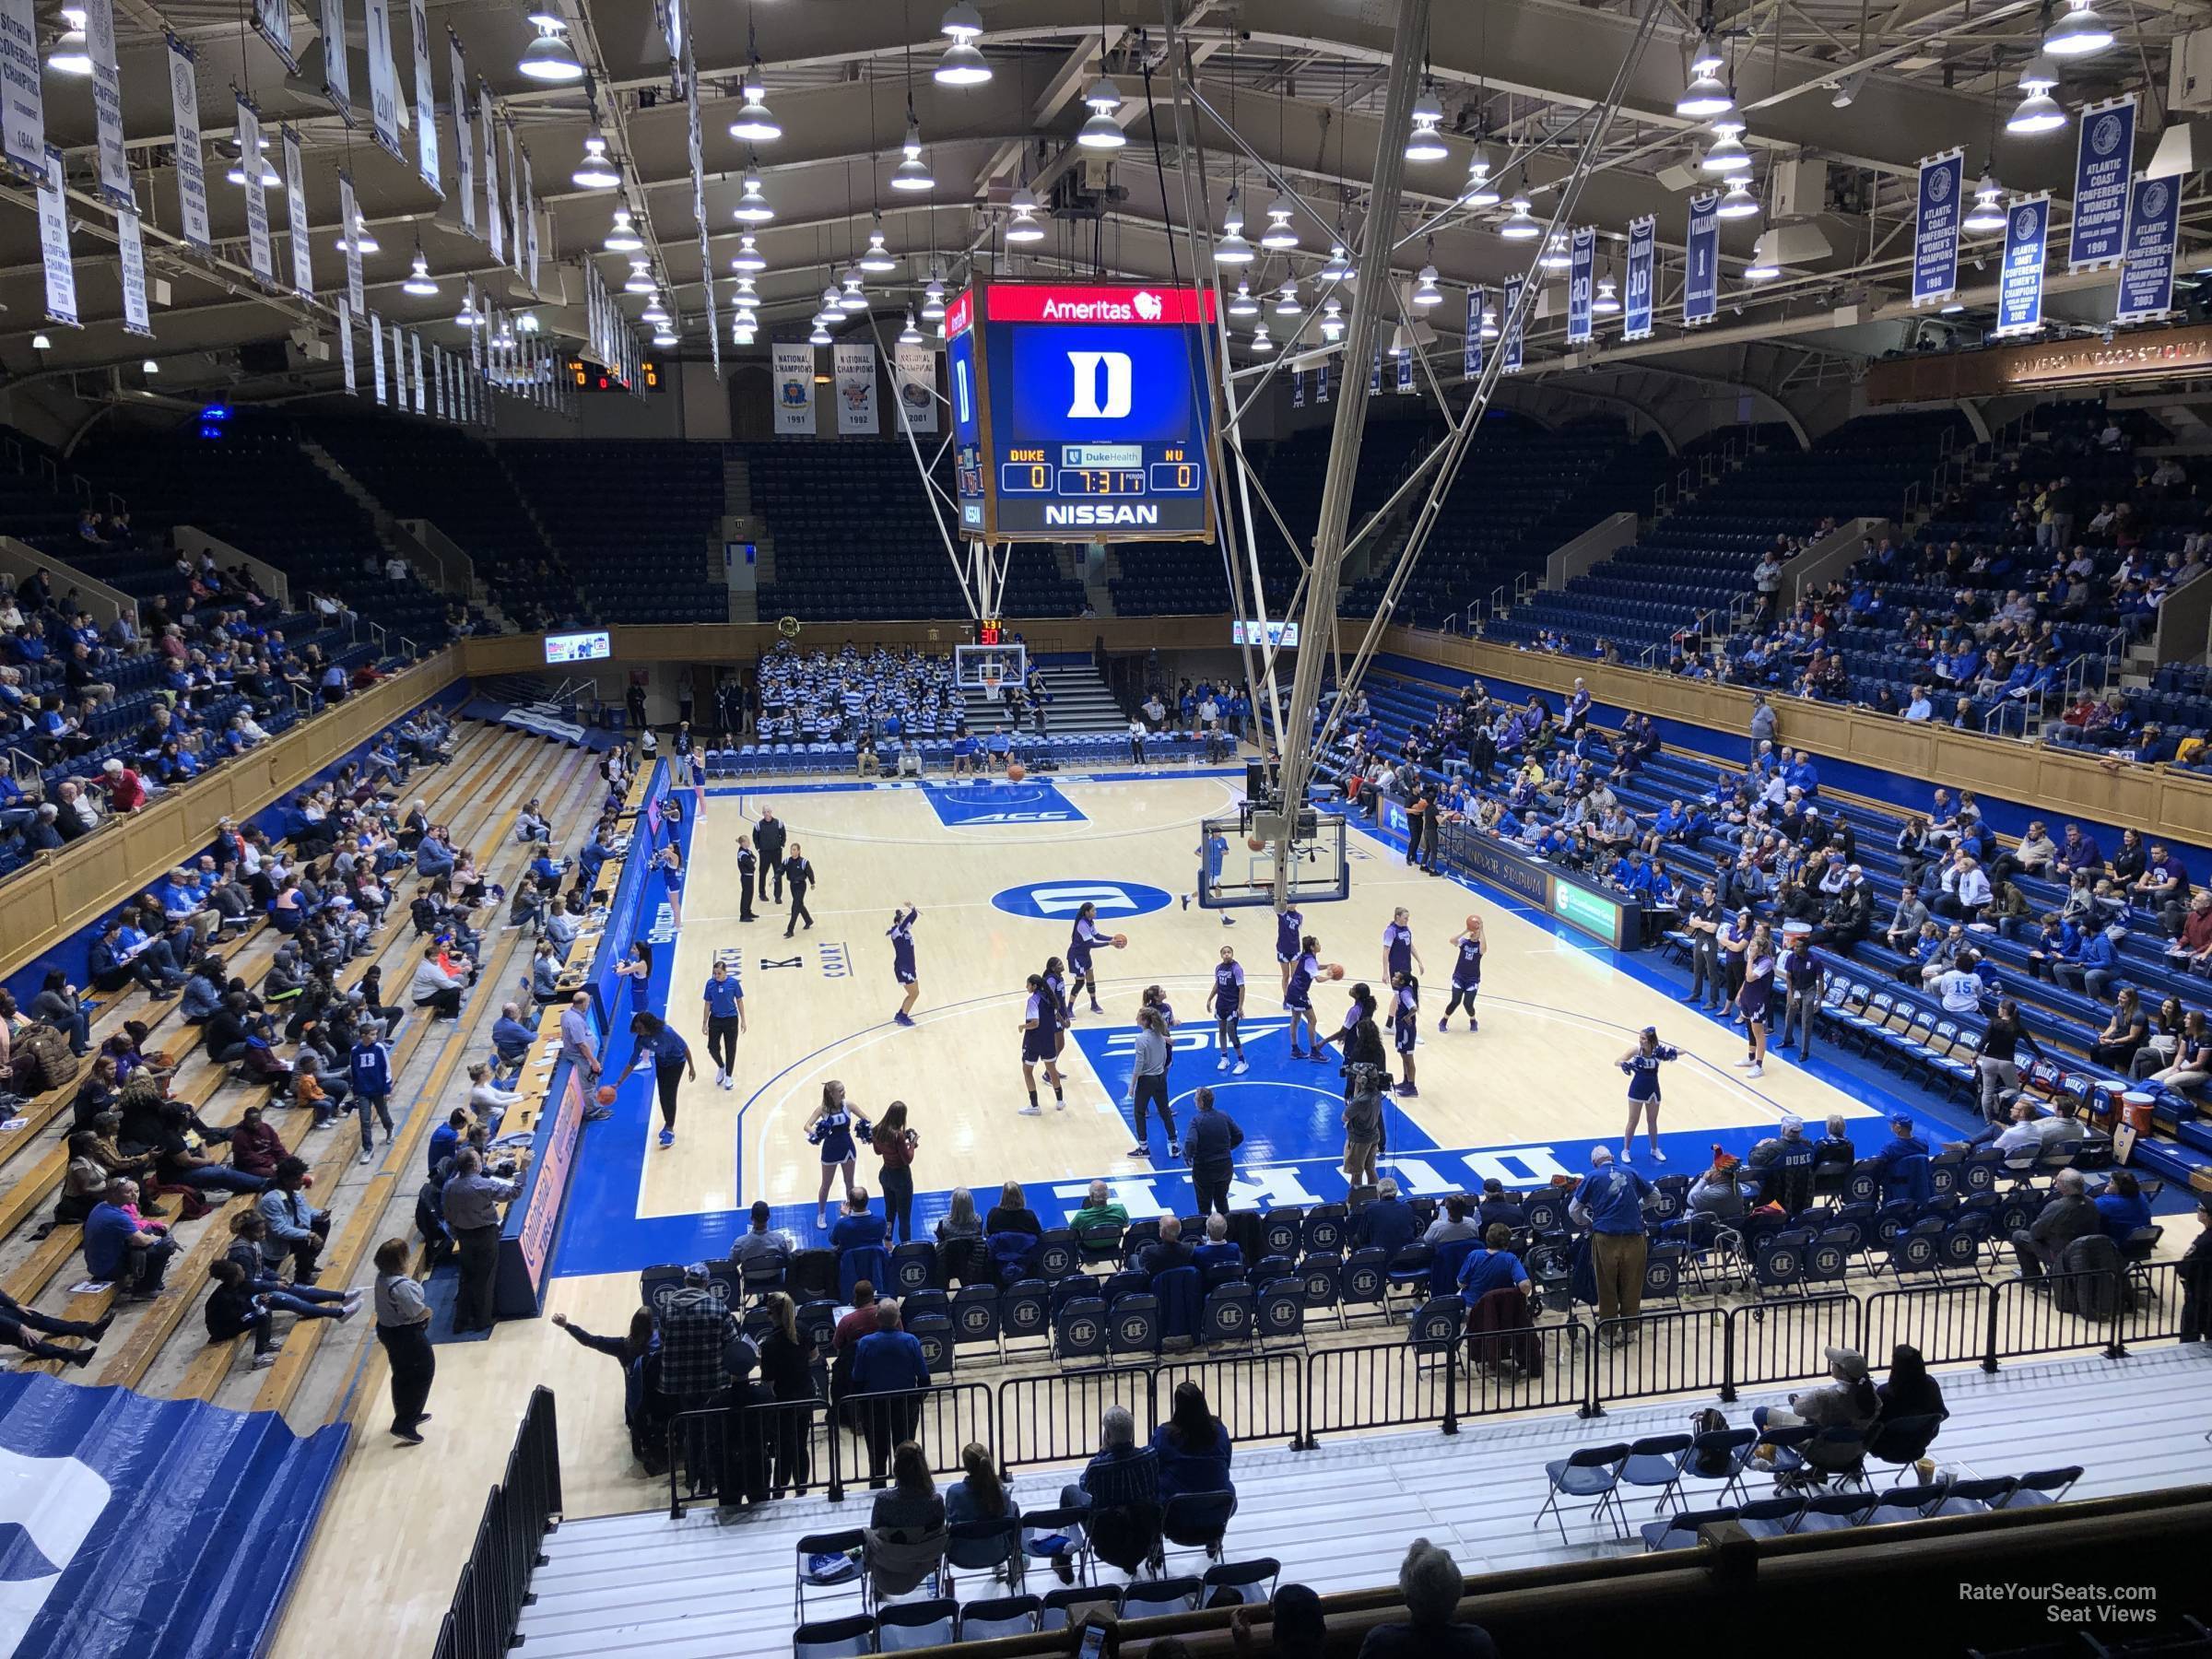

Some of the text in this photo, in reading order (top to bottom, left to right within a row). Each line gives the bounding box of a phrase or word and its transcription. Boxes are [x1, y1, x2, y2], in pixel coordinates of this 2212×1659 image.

[2087, 158, 2122, 176] ATLANTIC
[2090, 172, 2116, 187] COAST
[2078, 182, 2125, 202] CONFERENCE
[1924, 204, 1952, 220] ATLANTIC
[2083, 197, 2118, 214] WOMEN'S
[1928, 217, 1947, 230] COAST
[2077, 209, 2122, 228] CHAMPIONS
[1918, 226, 1956, 243] CONFERENCE
[2136, 221, 2168, 236] ATLANTIC
[1923, 239, 1950, 253] WOMEN'S
[2139, 233, 2161, 246] COAST
[2012, 243, 2038, 257] ATLANTIC
[2087, 241, 2108, 254] 1999
[2127, 242, 2172, 260] CONFERENCE
[1698, 249, 1705, 276] 1
[1919, 249, 1953, 265] CHAMPIONS
[2014, 254, 2033, 266] COAST
[2131, 255, 2165, 270] WOMEN'S
[2005, 264, 2041, 278] CONFERENCE
[2126, 267, 2168, 282] CHAMPIONS
[1572, 277, 1588, 301] 20
[1630, 269, 1647, 296] 10
[1926, 276, 1942, 289] 1998
[2009, 276, 2036, 288] WOMEN'S
[2004, 285, 2038, 300] CHAMPIONS
[1042, 298, 1132, 319] Ameritas
[778, 355, 809, 363] NATIONAL
[840, 355, 870, 364] NATIONAL
[775, 364, 813, 373] CHAMPIONS
[837, 365, 874, 373] CHAMPIONS
[577, 372, 585, 384] 0
[648, 372, 656, 384] 0
[1067, 351, 1132, 418] D
[850, 416, 868, 424] 1992
[1010, 450, 1044, 461] DUKE
[1086, 452, 1138, 462] DukeHealth
[1165, 450, 1183, 461] NU
[1031, 465, 1044, 488] 0
[1178, 465, 1190, 488] 0
[1045, 505, 1158, 524] NISSAN
[982, 619, 1002, 629] 7:31
[981, 629, 998, 644] 30
[954, 810, 1071, 824] ACC
[1503, 864, 1541, 896] STADIUM
[760, 956, 803, 971] K
[818, 942, 846, 978] COURT
[1955, 980, 1971, 994] 15
[1875, 994, 1892, 1008] DUKE
[1896, 1002, 1913, 1018] DUKE
[1918, 1012, 1934, 1027] DUKE
[1937, 1022, 1955, 1037] DUKE
[1960, 1032, 1981, 1047] DUKE
[2035, 1065, 2056, 1082] DUKE
[2065, 1078, 2085, 1094] DUKE
[1785, 1153, 1811, 1166] DUKE
[538, 1210, 553, 1263] TIRE
